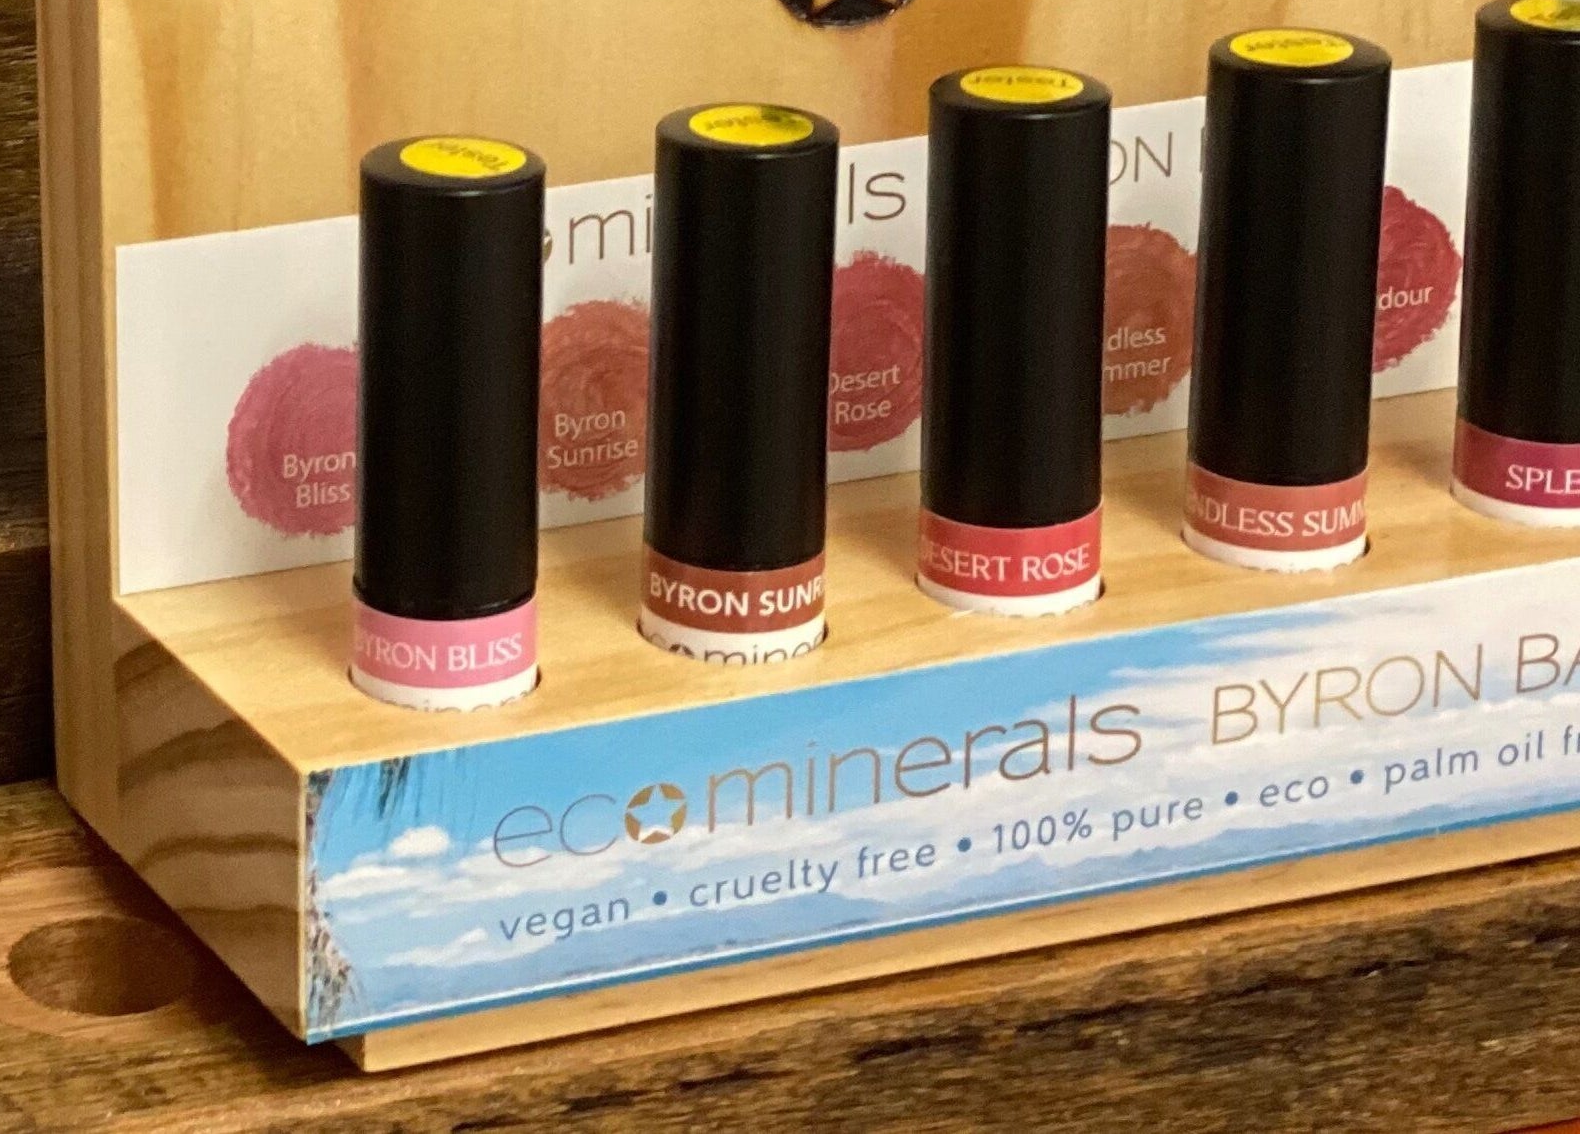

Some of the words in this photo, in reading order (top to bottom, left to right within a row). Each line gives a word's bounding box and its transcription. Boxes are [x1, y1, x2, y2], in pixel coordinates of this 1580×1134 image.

[1106, 324, 1168, 353] dless
[554, 407, 626, 440] Byron
[834, 397, 893, 425] Rose
[282, 450, 356, 483] Byron
[547, 436, 639, 469] Sunrise
[296, 482, 351, 509] Bliss
[1505, 463, 1580, 495] SPLE
[1021, 542, 1091, 582] ROSE
[649, 571, 750, 617] BYRON
[356, 629, 437, 672] YRON
[457, 631, 523, 672] BLISS
[1210, 642, 1485, 746] BYRON
[498, 892, 630, 943] vegan
[688, 854, 838, 909] cruelty
[857, 844, 938, 879] free
[991, 807, 1094, 856] 100%
[1111, 794, 1204, 842] pure
[1258, 774, 1331, 809] eco
[1383, 747, 1480, 795] palm
[1497, 728, 1544, 766] oil
